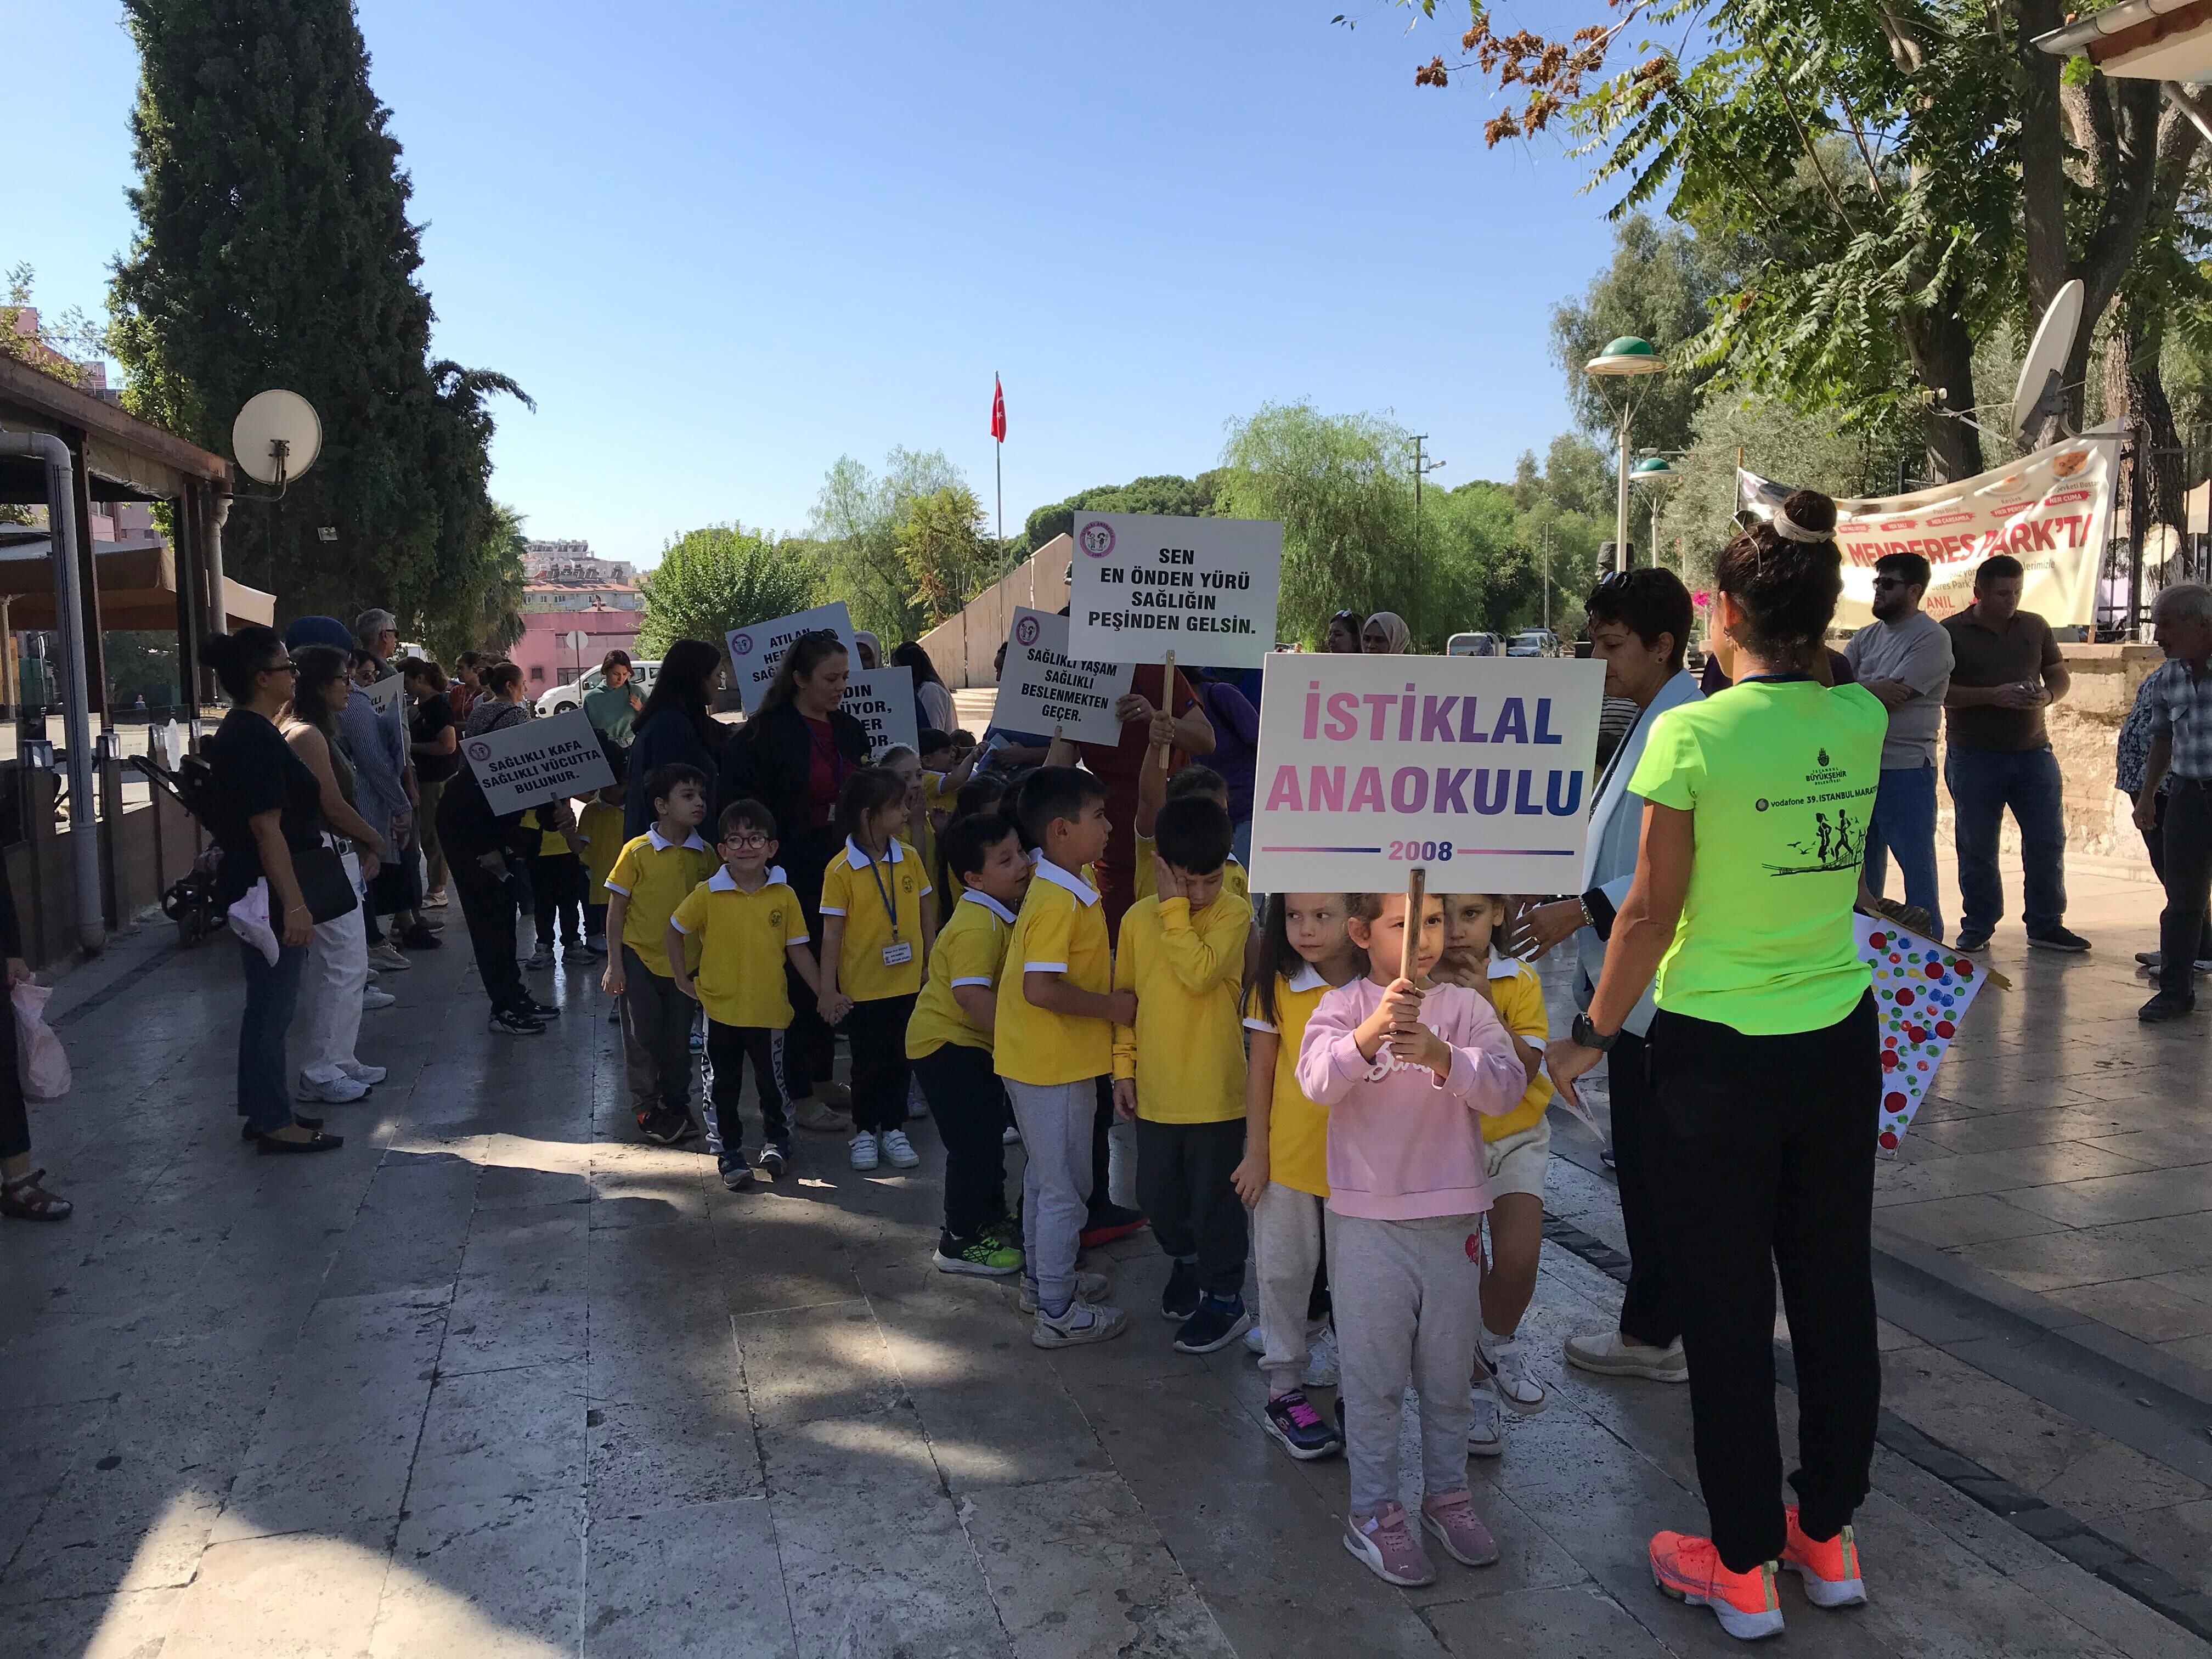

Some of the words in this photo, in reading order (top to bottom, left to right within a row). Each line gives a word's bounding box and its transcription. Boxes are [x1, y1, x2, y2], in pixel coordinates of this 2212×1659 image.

[2049, 495, 2062, 504] HER
[2064, 493, 2083, 501] CUMA
[1159, 548, 1194, 565] SEN
[2023, 558, 2055, 571] lerimizle
[1101, 567, 1124, 584] EN
[1131, 566, 1194, 587] ÖNDEN
[1200, 569, 1250, 590] YÜRÜ
[1131, 589, 1216, 610] SAĞLIĞIN
[1927, 595, 1956, 609] ANIL
[1088, 609, 1180, 631] PEŞİNDEN
[1187, 614, 1256, 634] GELSİN.
[764, 650, 786, 664] HE
[1027, 648, 1077, 669] SAĞLIKLI
[1081, 661, 1118, 676] YAŞAM
[752, 665, 778, 682] SAĞ
[1045, 669, 1094, 689] SAĞLIKLI
[843, 685, 872, 698] DIN
[1021, 683, 1109, 709] BESLENMEKTEN
[840, 701, 892, 715] ÜYOR,
[1042, 704, 1082, 722] GEÇER.
[1303, 681, 1562, 744] İSTİKLAL
[488, 749, 546, 772] SAĞLIKLI
[548, 740, 582, 757] KAFA
[482, 766, 539, 788] SAĞLIKLI
[540, 749, 601, 772] VÜCUTTA
[1805, 770, 1847, 782] BÜYÜKŞEHİR
[514, 770, 580, 794] BULUNUR.
[1265, 765, 1583, 816] ANAOKULU
[1770, 798, 1804, 808] vodafone
[1807, 796, 1819, 804] 39.
[1855, 785, 1878, 798] MARAT
[1389, 840, 1453, 861] 2008
